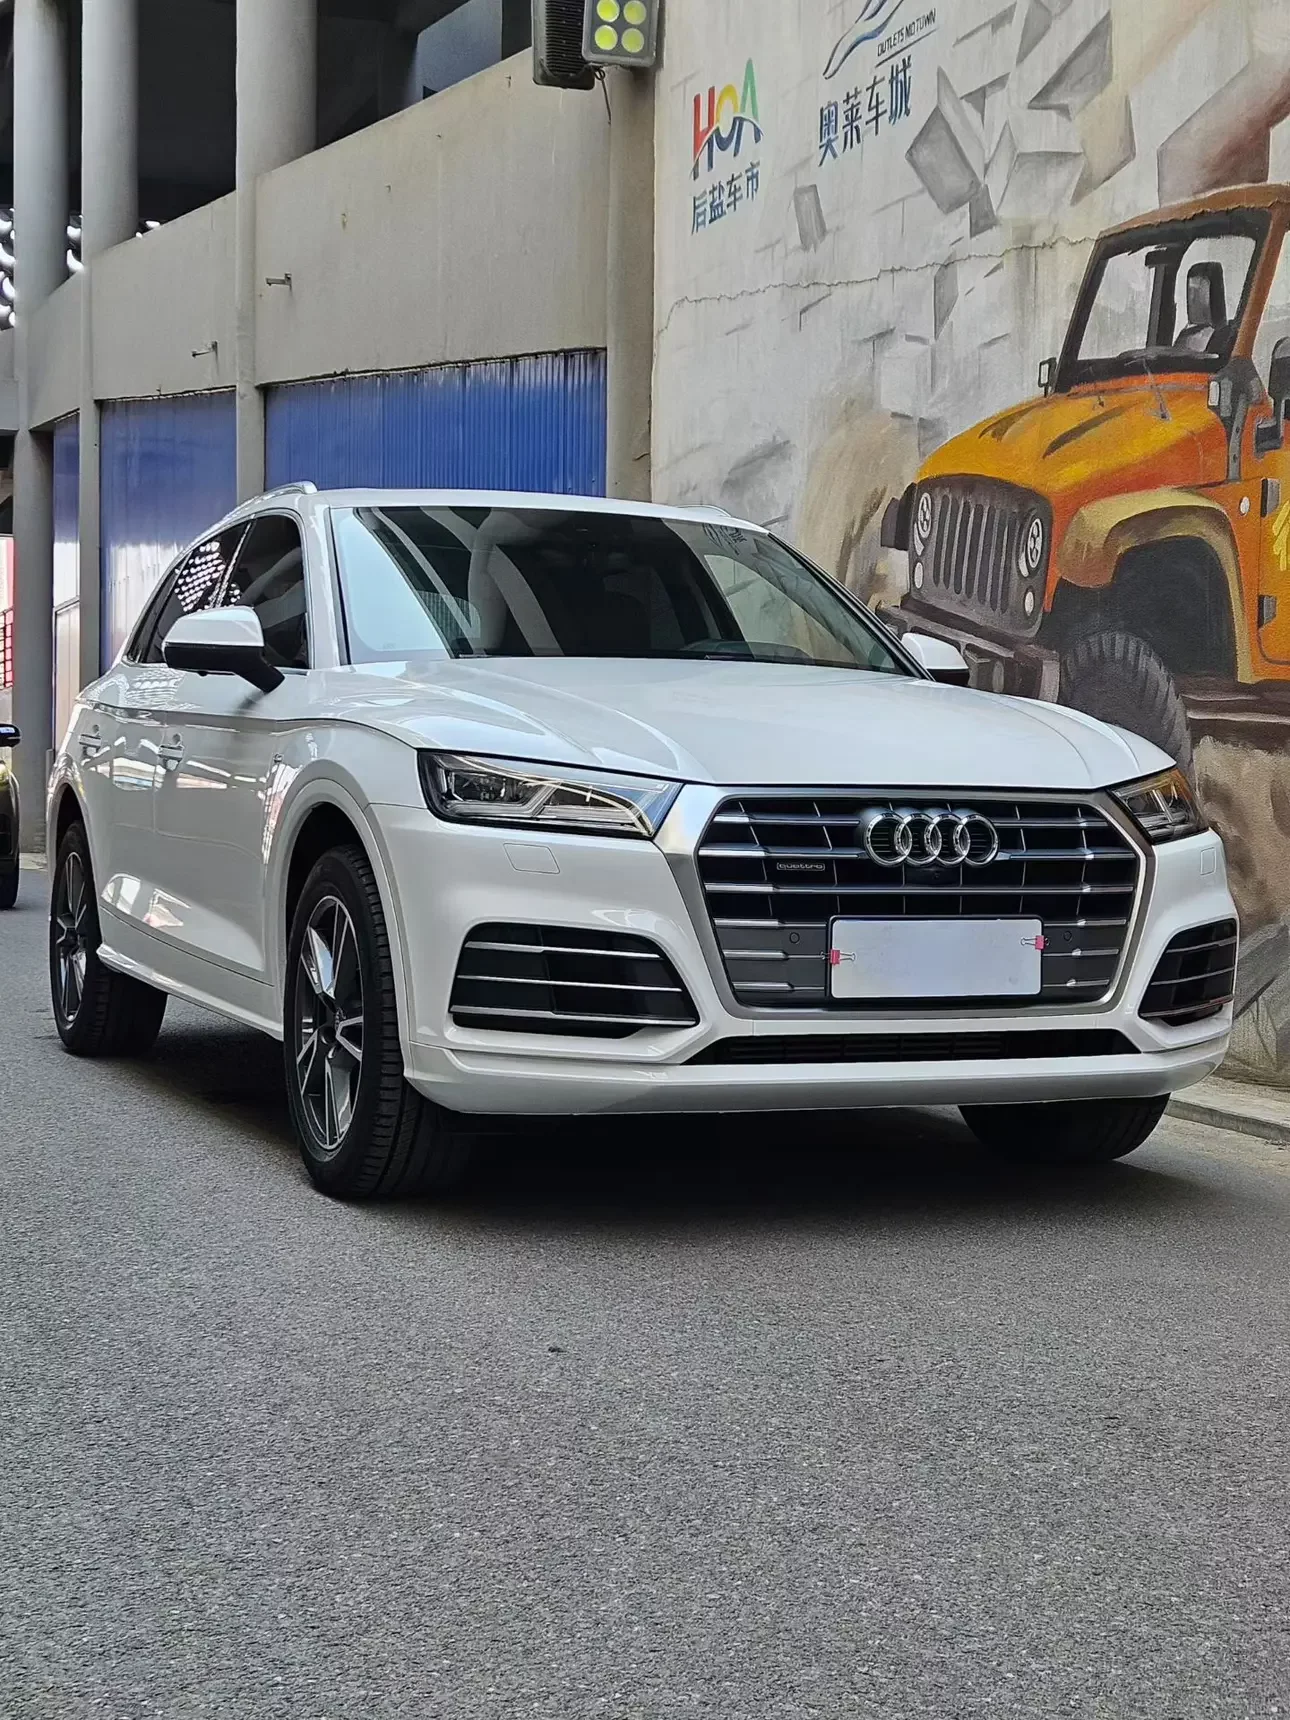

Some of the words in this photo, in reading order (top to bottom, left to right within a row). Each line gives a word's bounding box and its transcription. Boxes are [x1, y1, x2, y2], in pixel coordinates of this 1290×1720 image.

[877, 27, 905, 57] OUTLETS
[818, 54, 912, 167] 奥莱车城
[691, 160, 761, 236] 后盐车市
[778, 862, 824, 871] quattro
